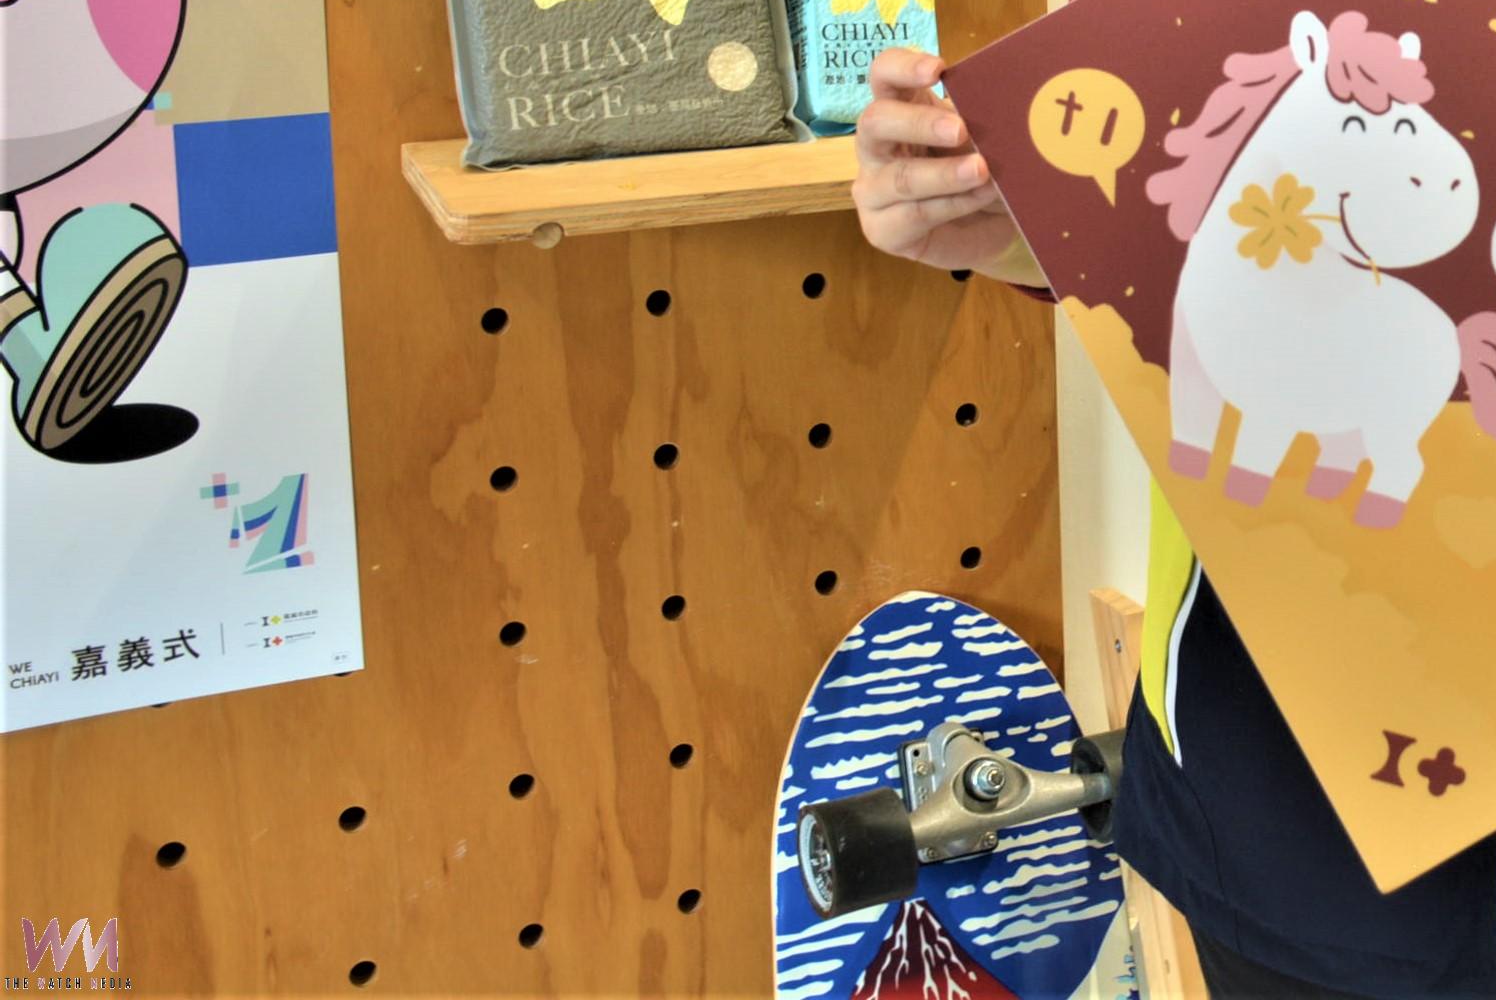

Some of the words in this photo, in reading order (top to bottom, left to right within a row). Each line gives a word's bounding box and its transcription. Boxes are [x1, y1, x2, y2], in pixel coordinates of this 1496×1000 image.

[822, 22, 909, 40] CHIAYI
[499, 29, 677, 78] CHIAYI
[508, 84, 630, 131] RICE
[8, 661, 32, 674] WE
[71, 628, 200, 681] 嘉義式
[9, 671, 60, 689] CHIAYI
